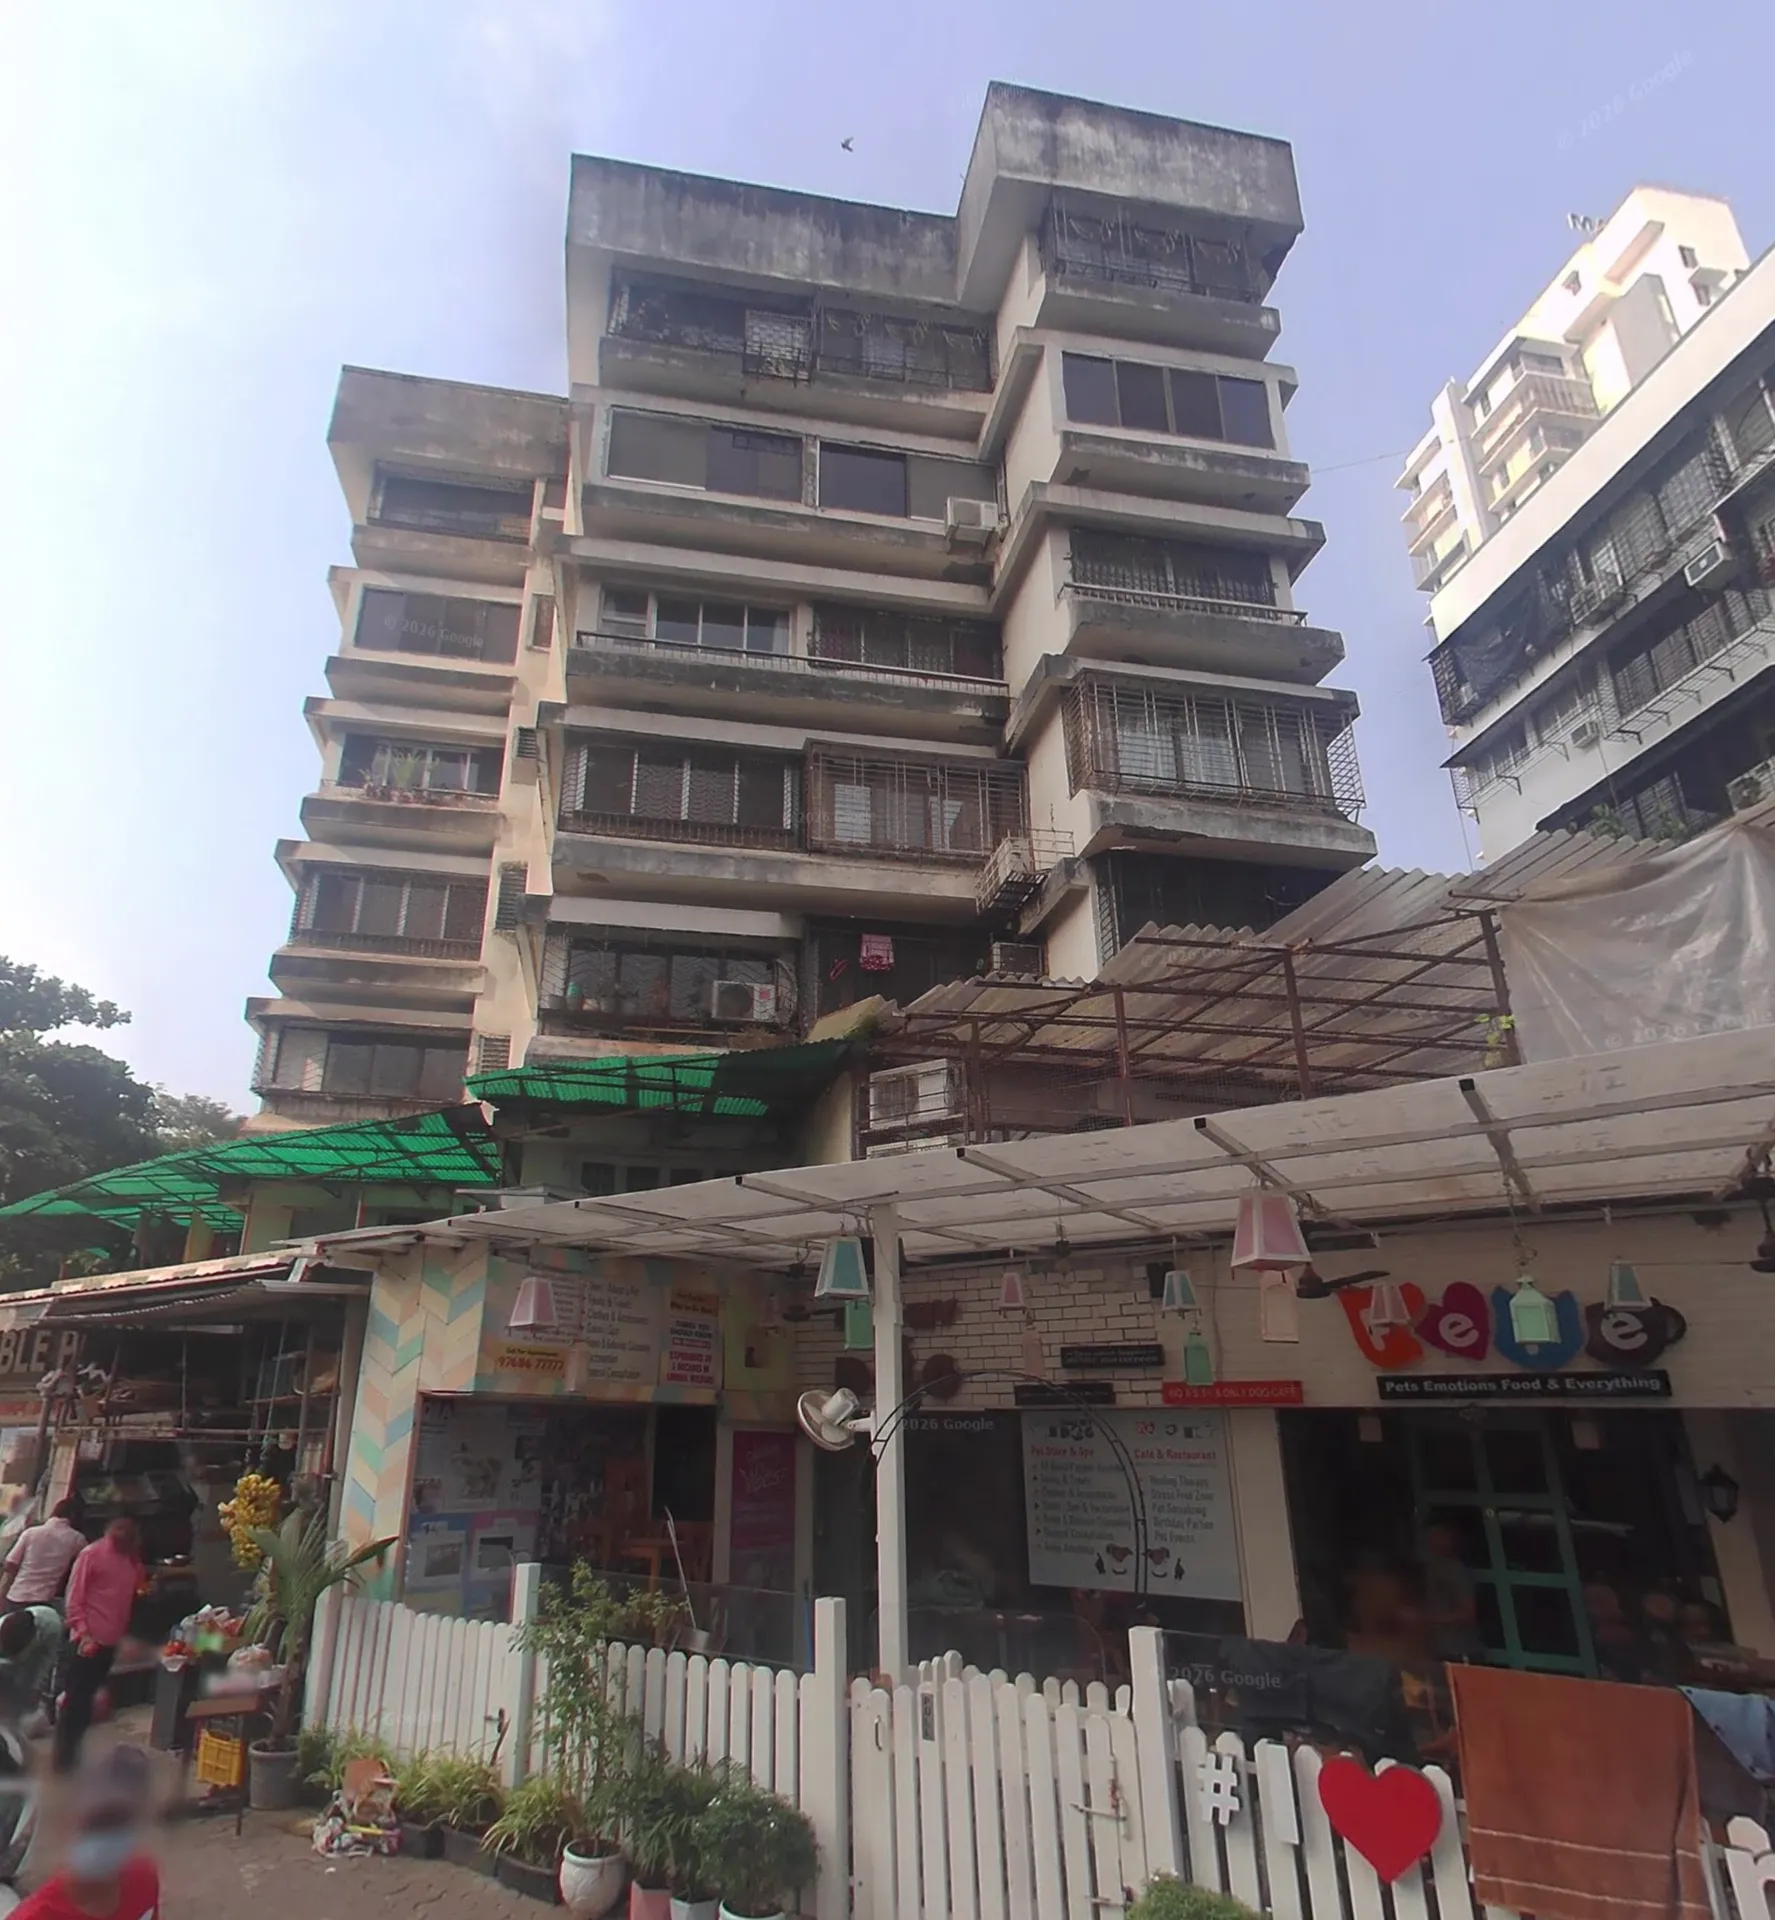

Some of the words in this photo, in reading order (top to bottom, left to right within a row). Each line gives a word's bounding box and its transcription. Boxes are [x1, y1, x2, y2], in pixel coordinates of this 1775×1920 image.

[1385, 1380, 1419, 1393] Pets
[1424, 1380, 1497, 1392] Emotions
[1502, 1379, 1542, 1391] Food
[1547, 1378, 1560, 1390] &
[1565, 1377, 1661, 1393] Everything
[1166, 1448, 1217, 1460] Restaurant
